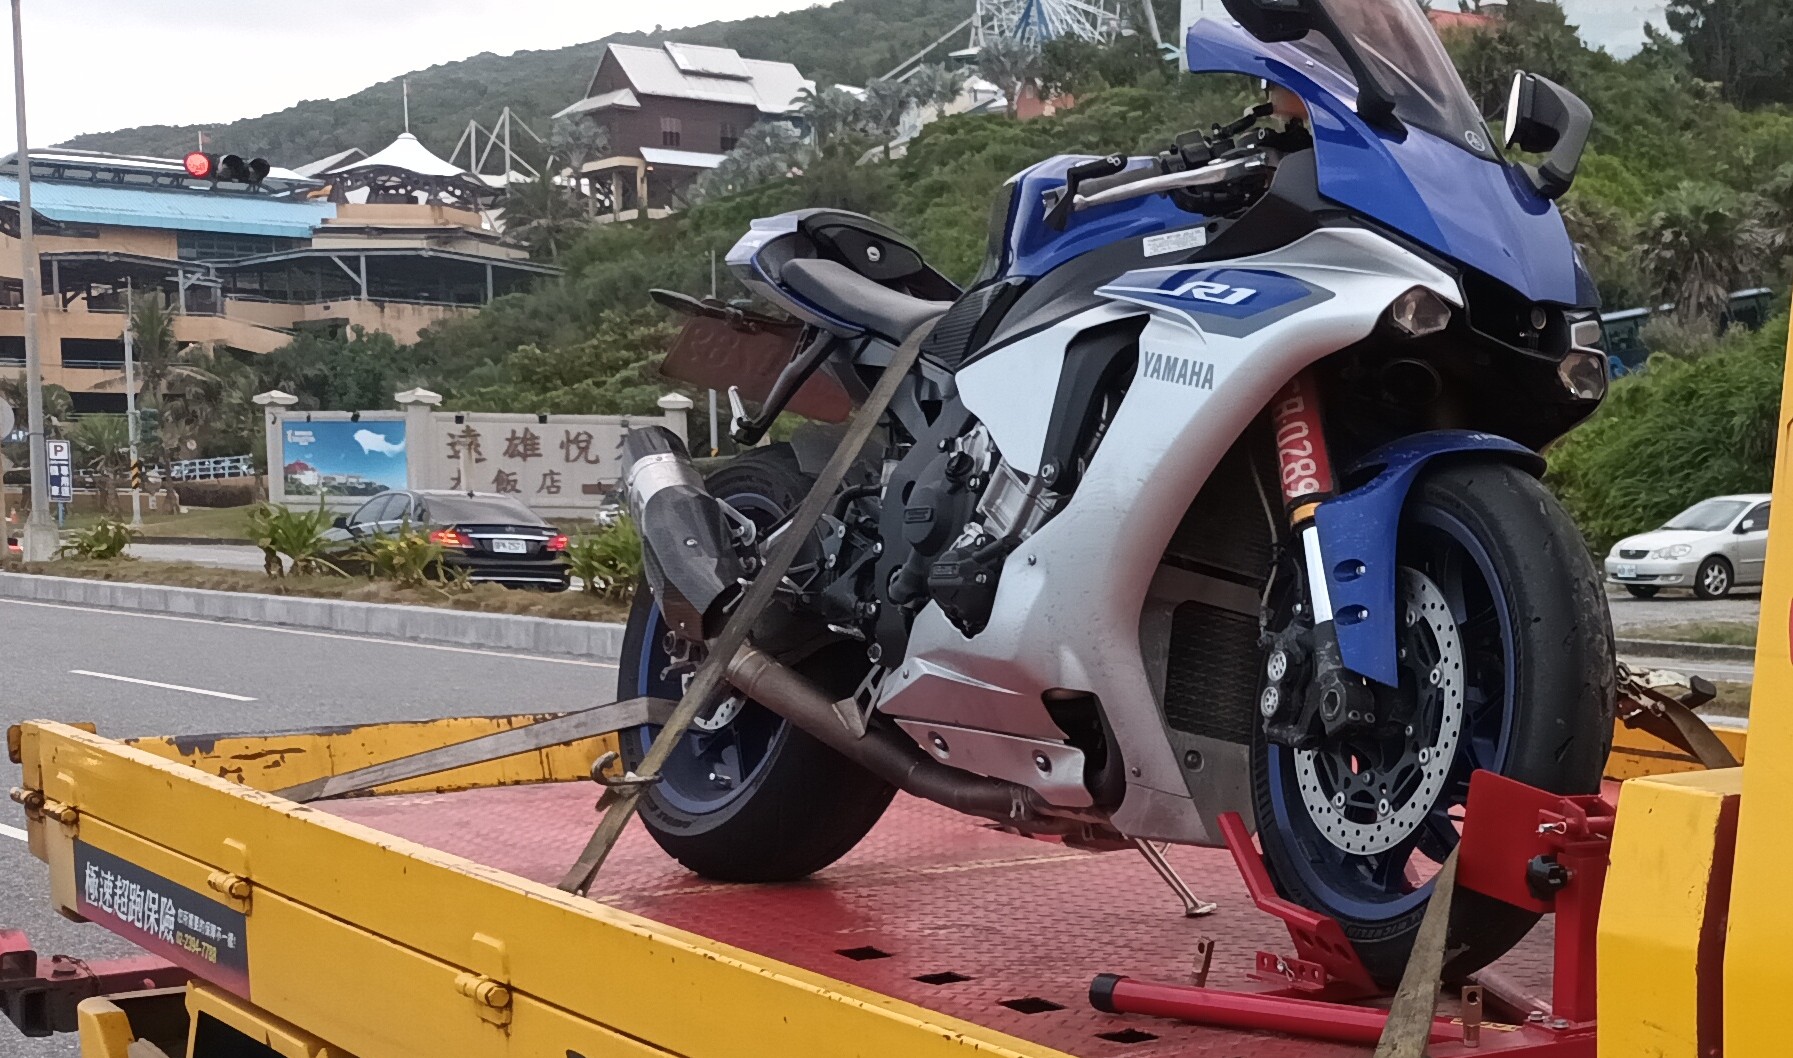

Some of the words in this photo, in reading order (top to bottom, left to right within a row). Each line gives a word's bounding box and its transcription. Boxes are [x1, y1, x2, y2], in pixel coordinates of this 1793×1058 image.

[1172, 281, 1257, 305] R1
[1142, 351, 1216, 390] YAMAHA
[54, 445, 65, 457] P
[446, 425, 627, 465] 遠雄悅
[85, 861, 176, 945] 極速超跑保險
